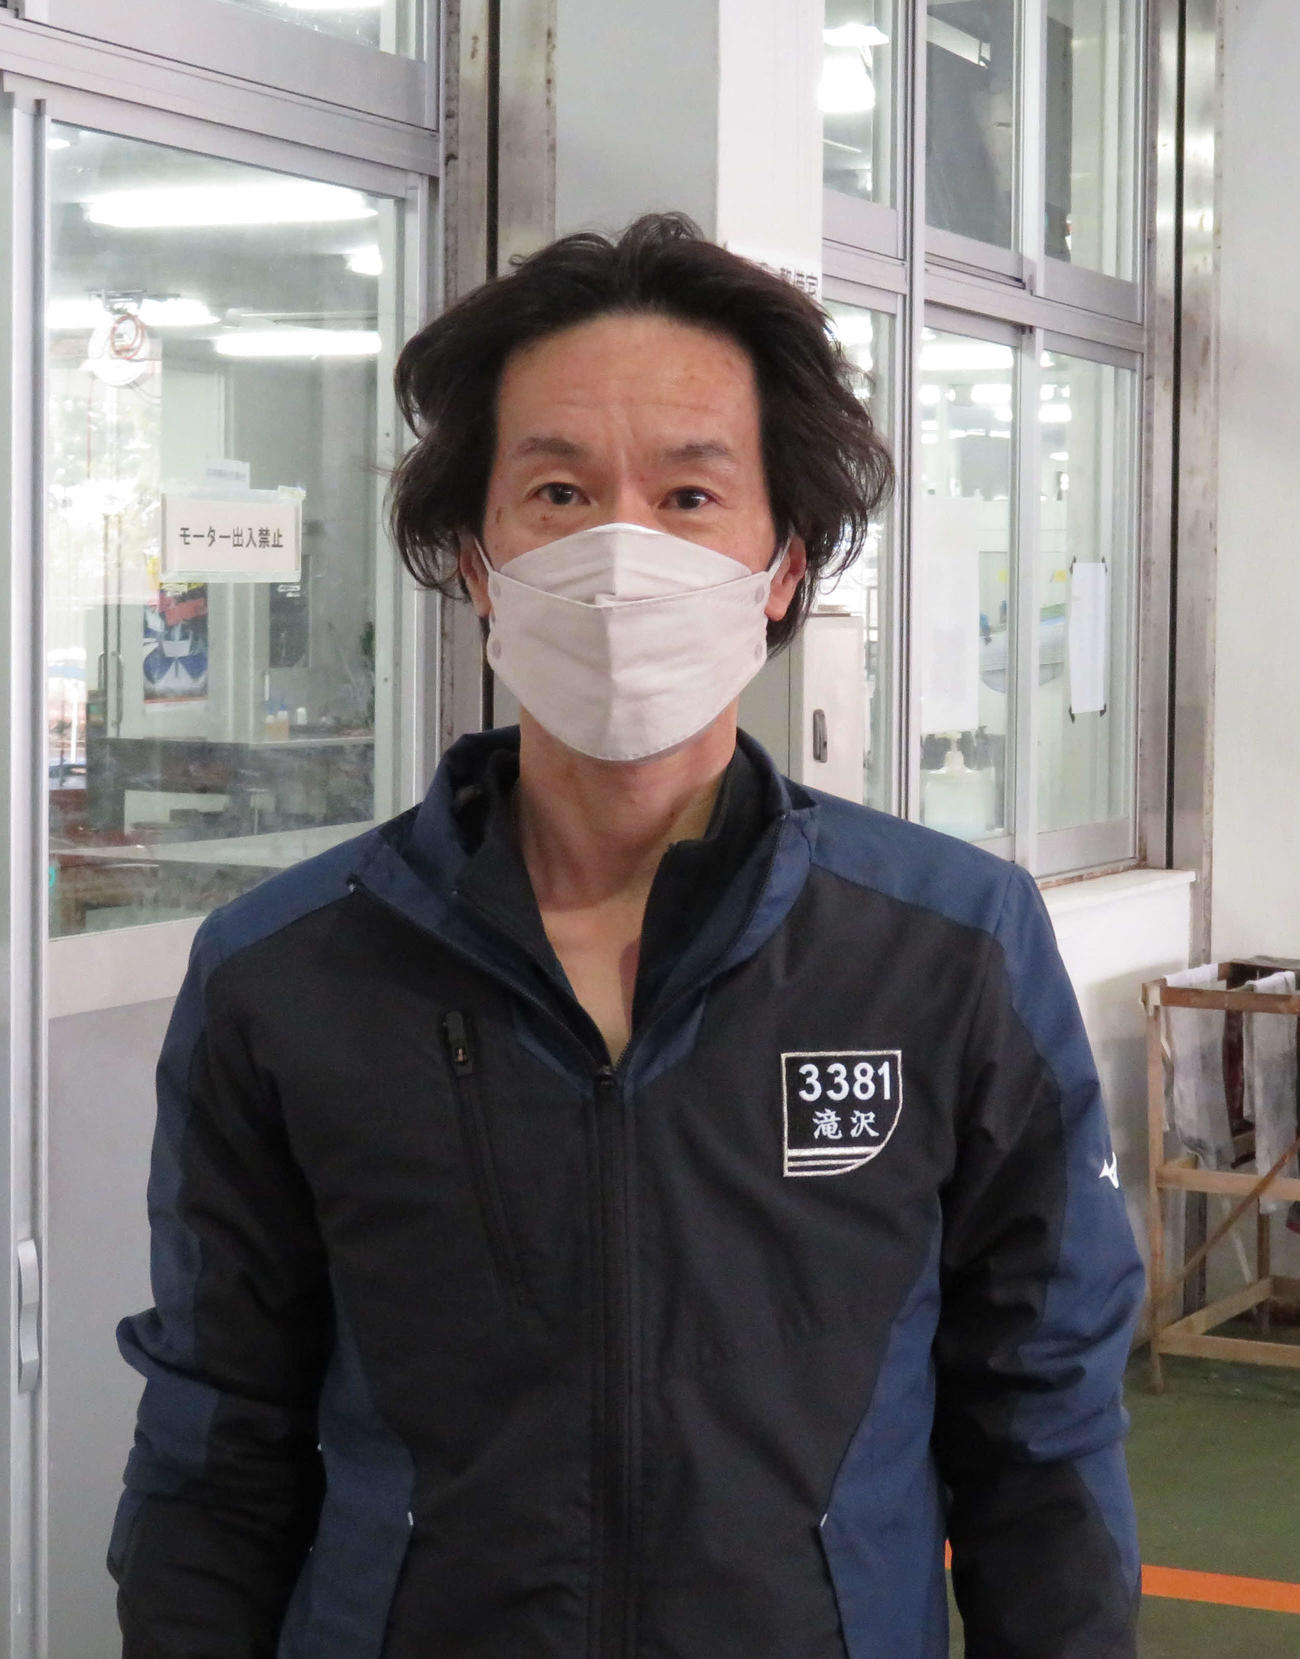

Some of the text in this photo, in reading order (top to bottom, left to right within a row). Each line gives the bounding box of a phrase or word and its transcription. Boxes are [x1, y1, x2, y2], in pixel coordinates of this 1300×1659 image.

[179, 526, 283, 549] モーター出入禁止
[798, 1061, 891, 1102] 3381
[812, 1108, 880, 1140] 滝沢
